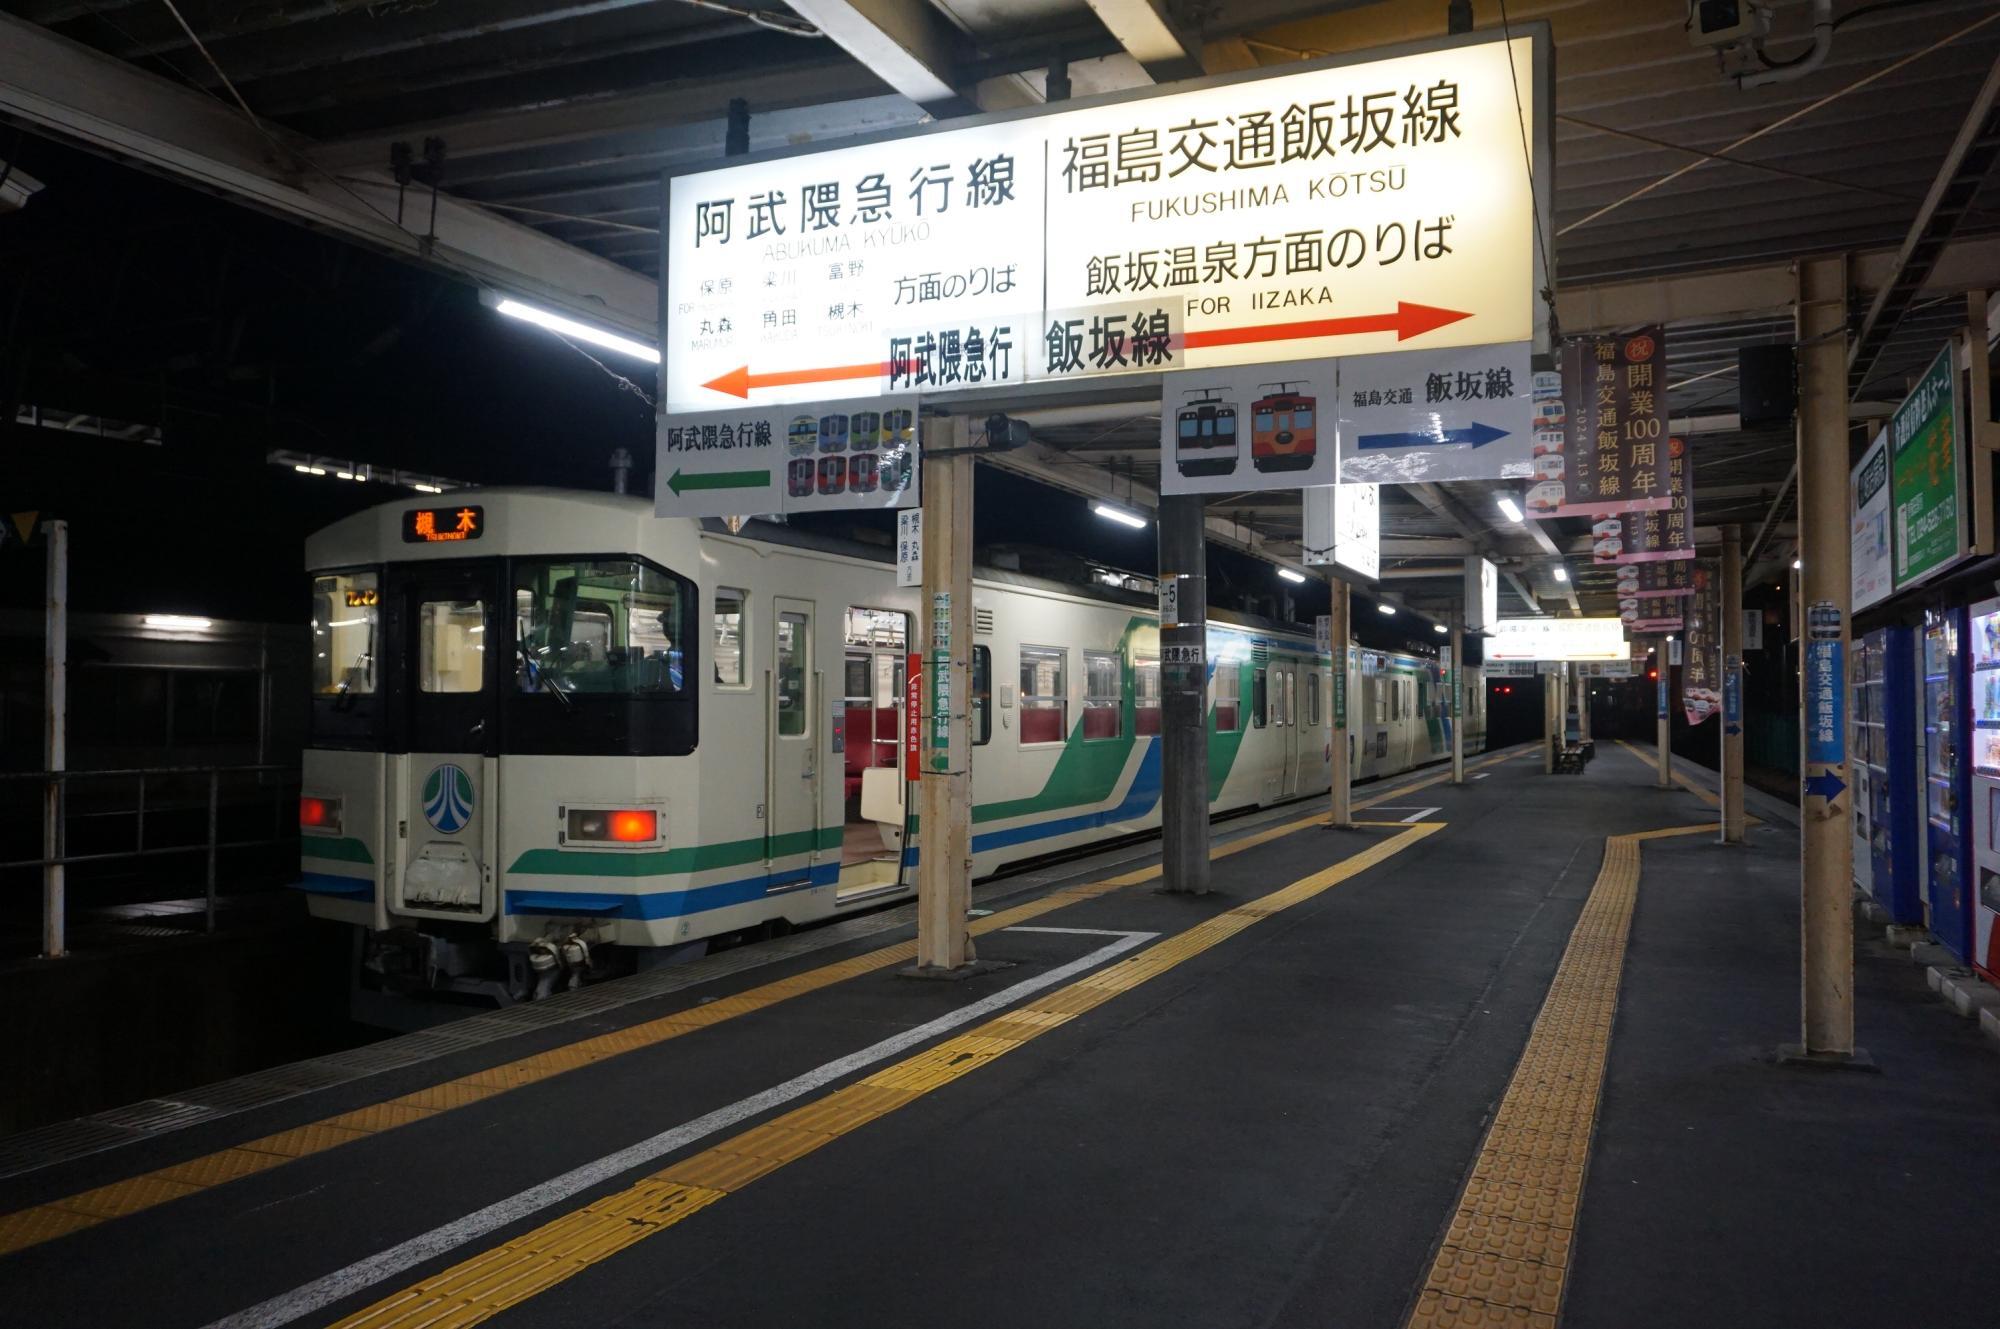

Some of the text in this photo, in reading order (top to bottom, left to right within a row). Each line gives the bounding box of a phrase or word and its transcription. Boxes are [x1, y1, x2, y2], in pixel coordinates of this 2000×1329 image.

[1062, 79, 1462, 194] 福島交通飯坂線
[695, 153, 1016, 248] 阿武隈急行線
[1131, 183, 1290, 222] FUKUSHIMA
[762, 233, 851, 264] ABUKUMA
[1086, 214, 1456, 298] 飯坂温泉方面のりば
[894, 263, 1017, 306] 方面のりば
[1187, 287, 1333, 317] FOR IIZAKA
[700, 315, 733, 337] 丸森
[762, 308, 797, 328] 角田
[691, 336, 736, 352] MARUMOR
[890, 325, 1013, 391] 阿武隈急行
[1045, 307, 1173, 375] 飯坂線
[1353, 366, 1514, 408] 福島交通 飯坂線
[667, 420, 772, 453] 阿武隈急行線
[1594, 342, 1621, 496] 福島交通飯坂線
[1624, 363, 1661, 494] 開業100周年
[1160, 647, 1199, 663] 武隈急行
